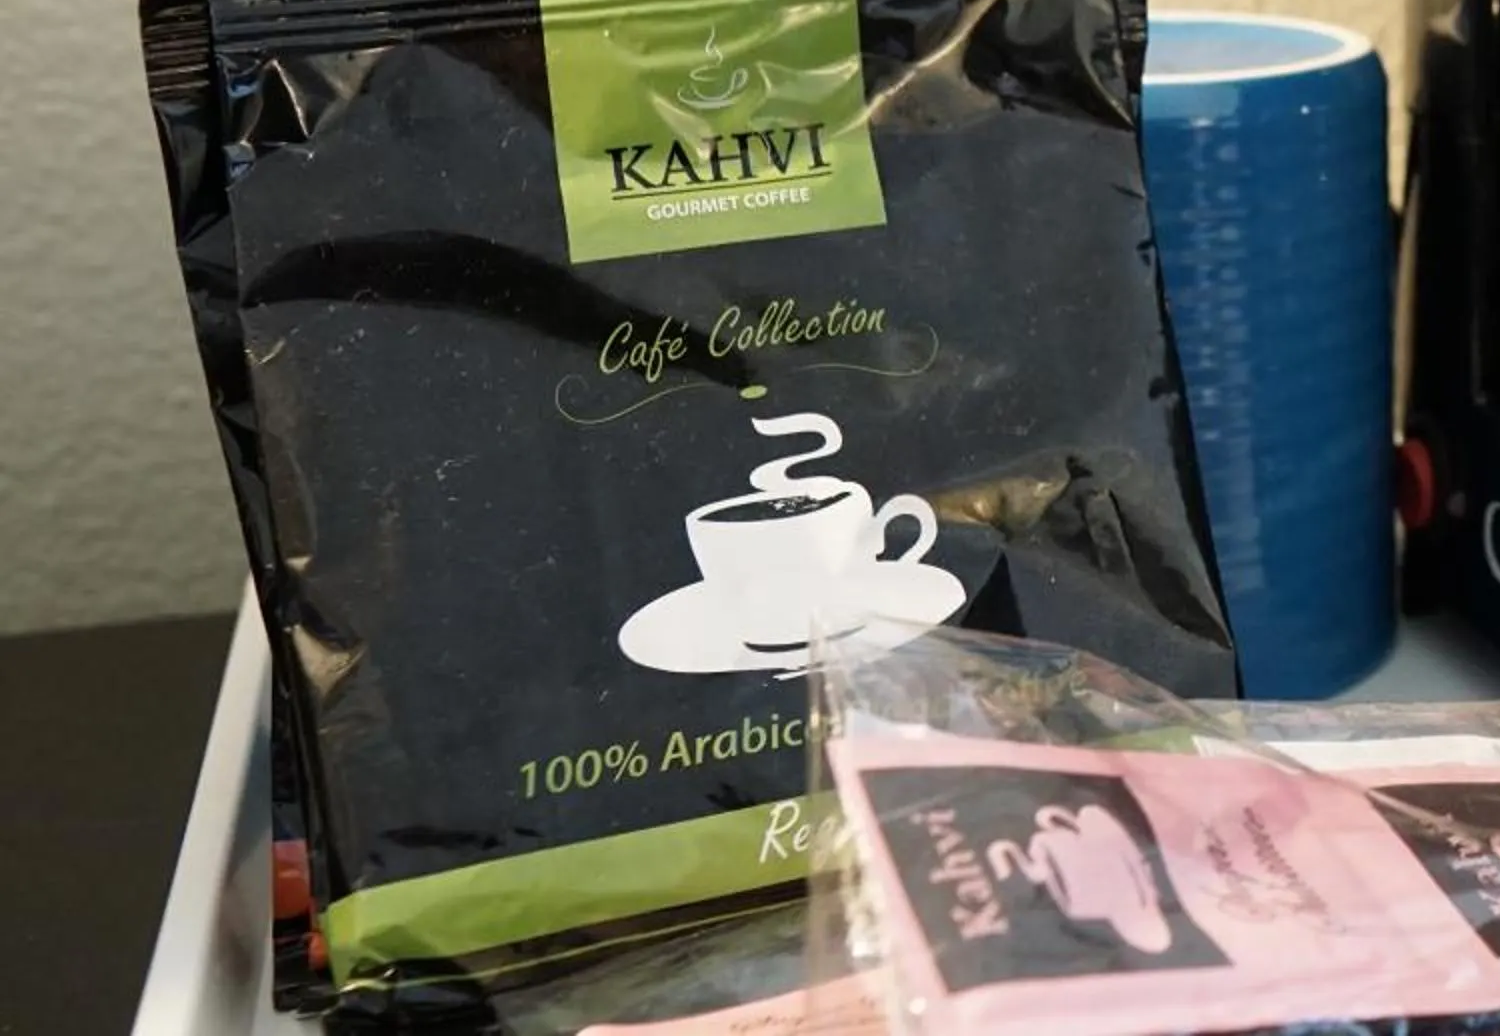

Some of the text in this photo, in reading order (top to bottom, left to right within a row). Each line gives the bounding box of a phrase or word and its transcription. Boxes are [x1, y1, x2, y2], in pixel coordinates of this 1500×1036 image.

[604, 122, 826, 193] KAHVI
[647, 187, 811, 221] GOURMET COFFEE
[599, 298, 886, 383] Café Collection
[519, 740, 649, 798] 100%
